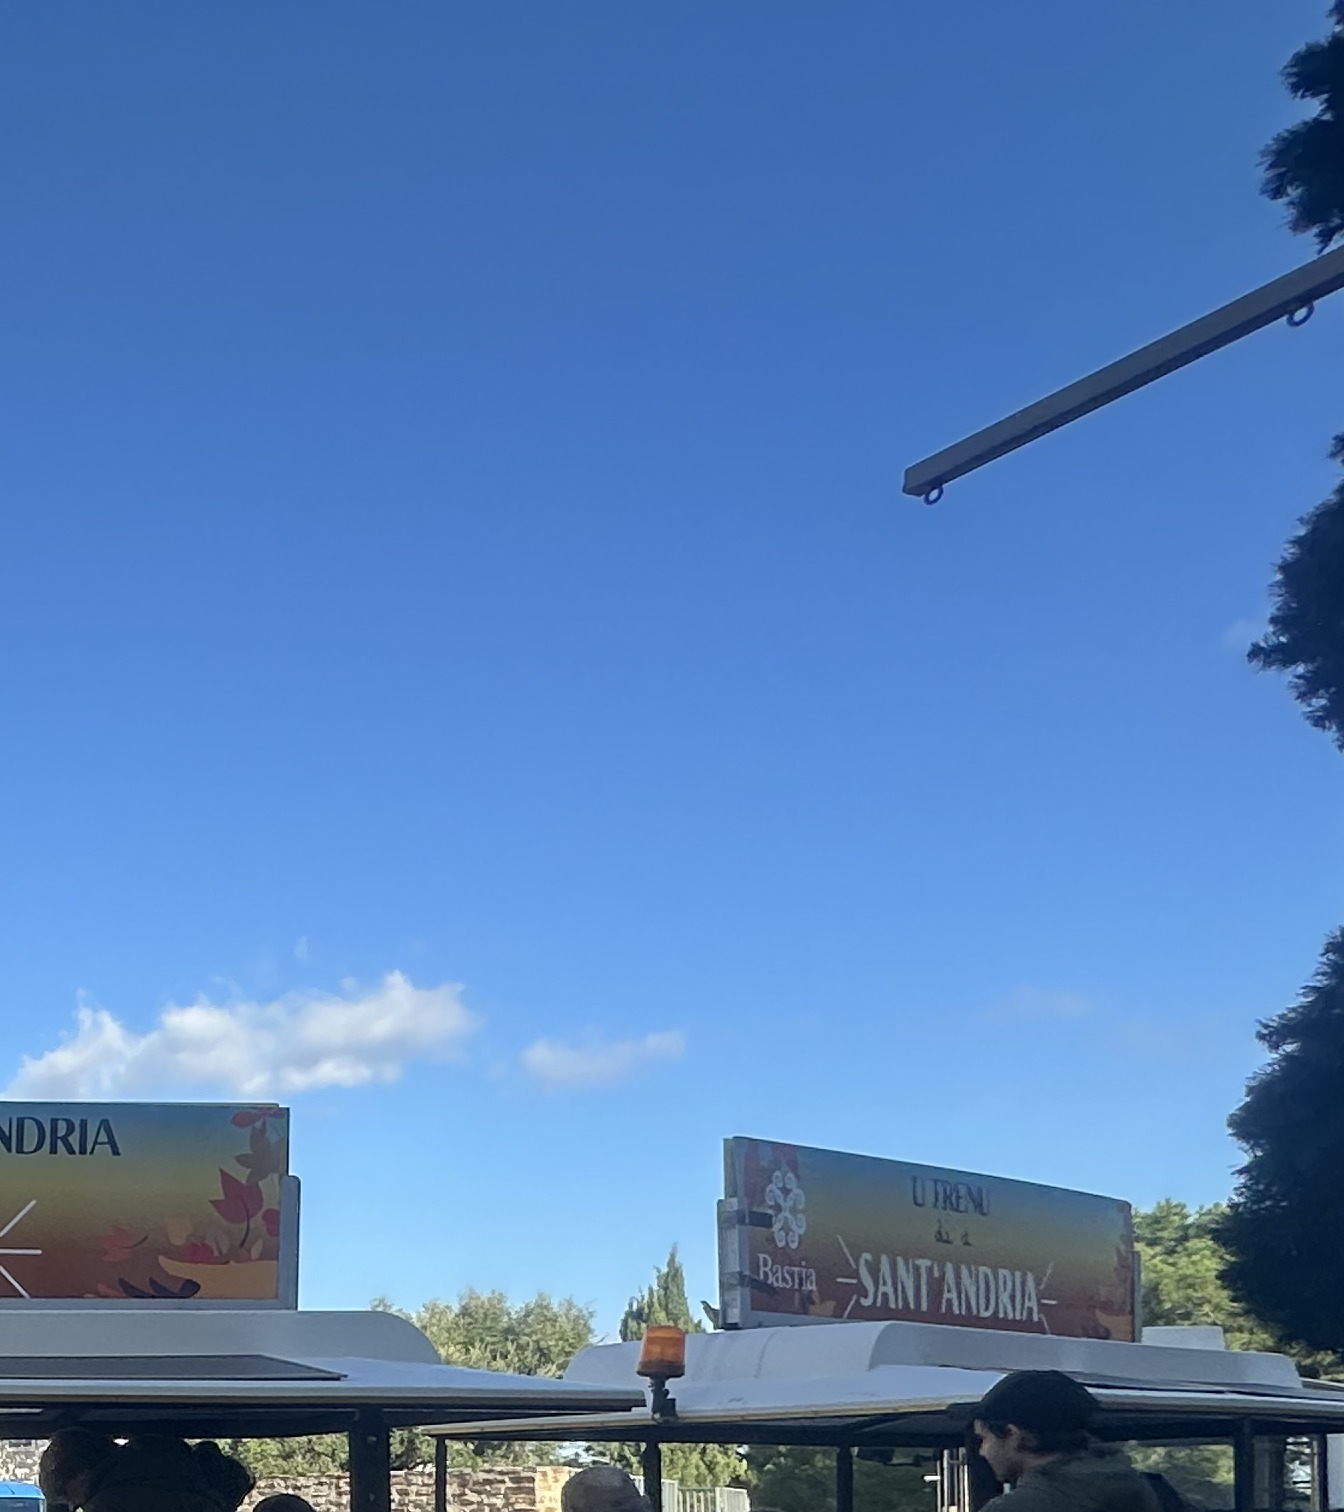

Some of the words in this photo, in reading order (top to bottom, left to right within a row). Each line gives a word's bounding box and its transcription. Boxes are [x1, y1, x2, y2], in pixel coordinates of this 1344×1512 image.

[911, 1175, 925, 1207] U
[930, 1178, 992, 1216] TRENU
[757, 1253, 817, 1291] Bastia
[858, 1252, 1040, 1322] SANT'ANDRIA
